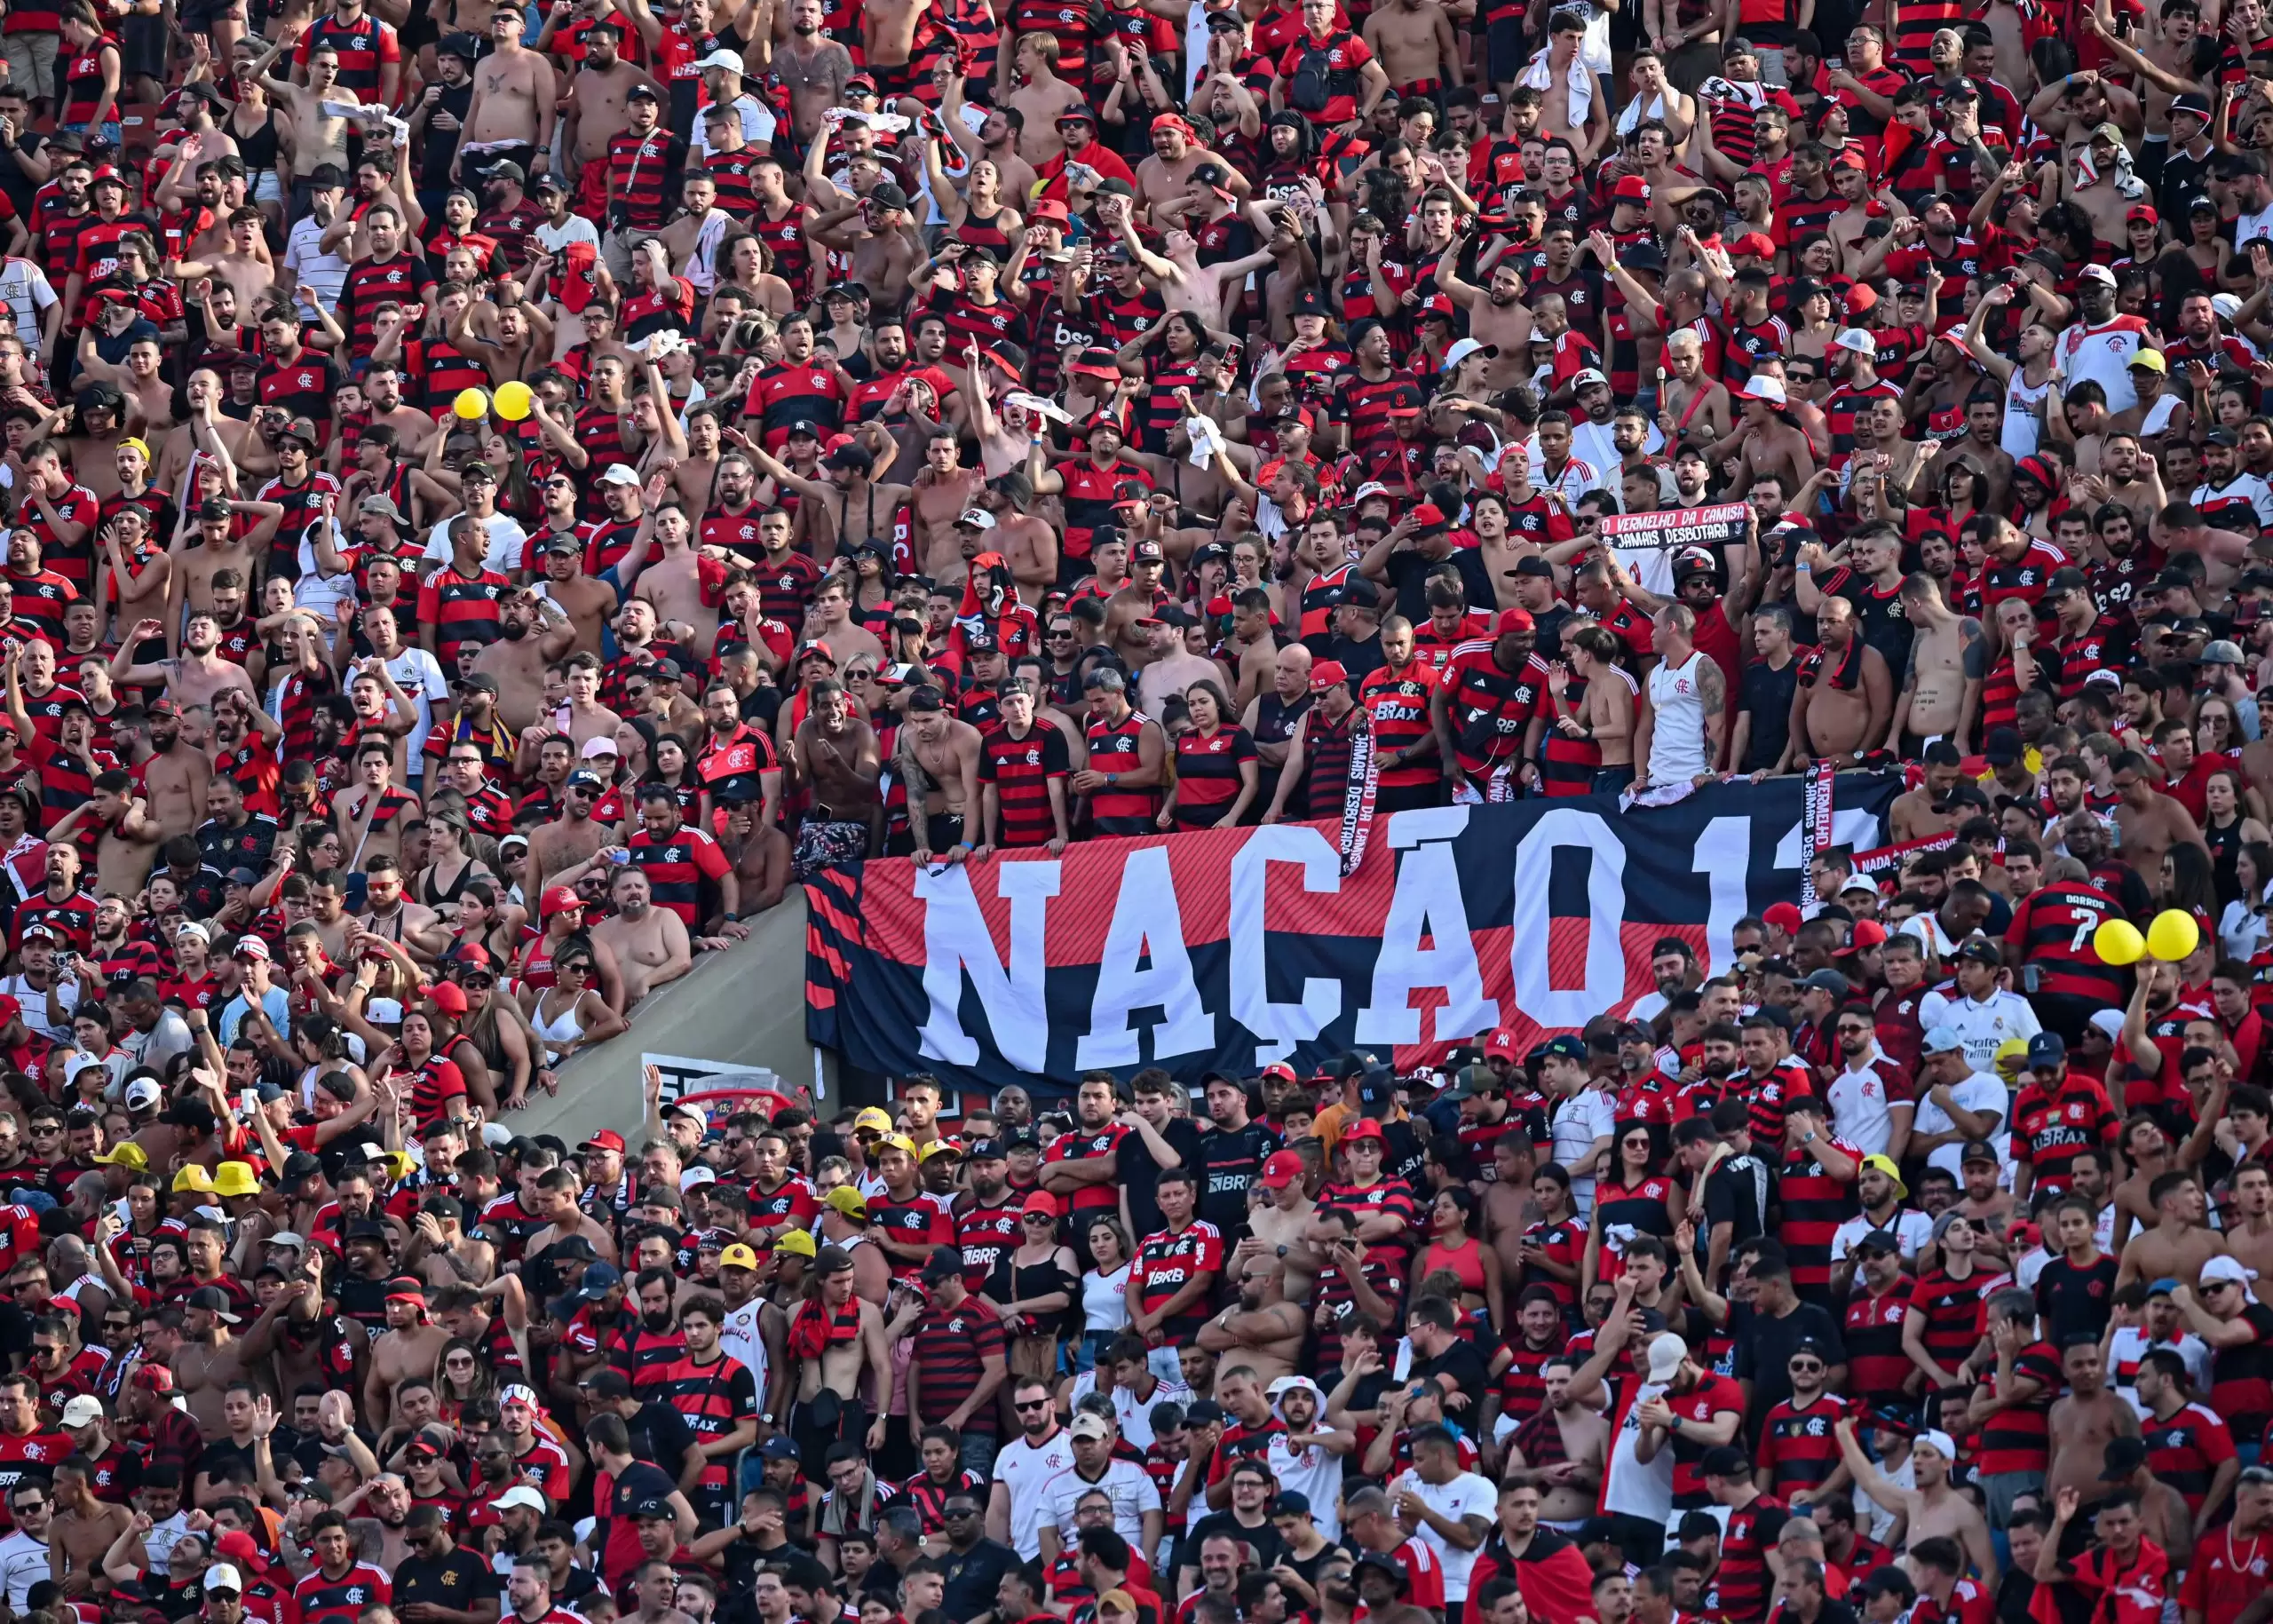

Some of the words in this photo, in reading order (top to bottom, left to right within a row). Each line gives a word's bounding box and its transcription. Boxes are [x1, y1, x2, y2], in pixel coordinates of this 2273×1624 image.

[171, 292, 182, 317] HAVAN
[1055, 322, 1094, 347] bs2
[1601, 519, 1611, 535] O
[1617, 512, 1676, 532] VERMELHO
[1681, 511, 1697, 525] DA
[1702, 504, 1745, 524] CAMISA
[1617, 531, 1660, 549] JAMAIS
[1665, 519, 1730, 543] DESBOTARÁ
[1350, 733, 1369, 780] JAMAIS
[1359, 804, 1374, 822] DA
[1805, 781, 1818, 829] JAMAIS
[1816, 777, 1832, 846] VERMELHO
[1340, 786, 1364, 855] DESBOTARÁ
[1862, 855, 1891, 874] NADA
[914, 805, 1627, 1073] NAÇÃO
[2070, 907, 2098, 953] 7
[2032, 1125, 2087, 1153] UBRAX
[1152, 1267, 1185, 1286] BRB
